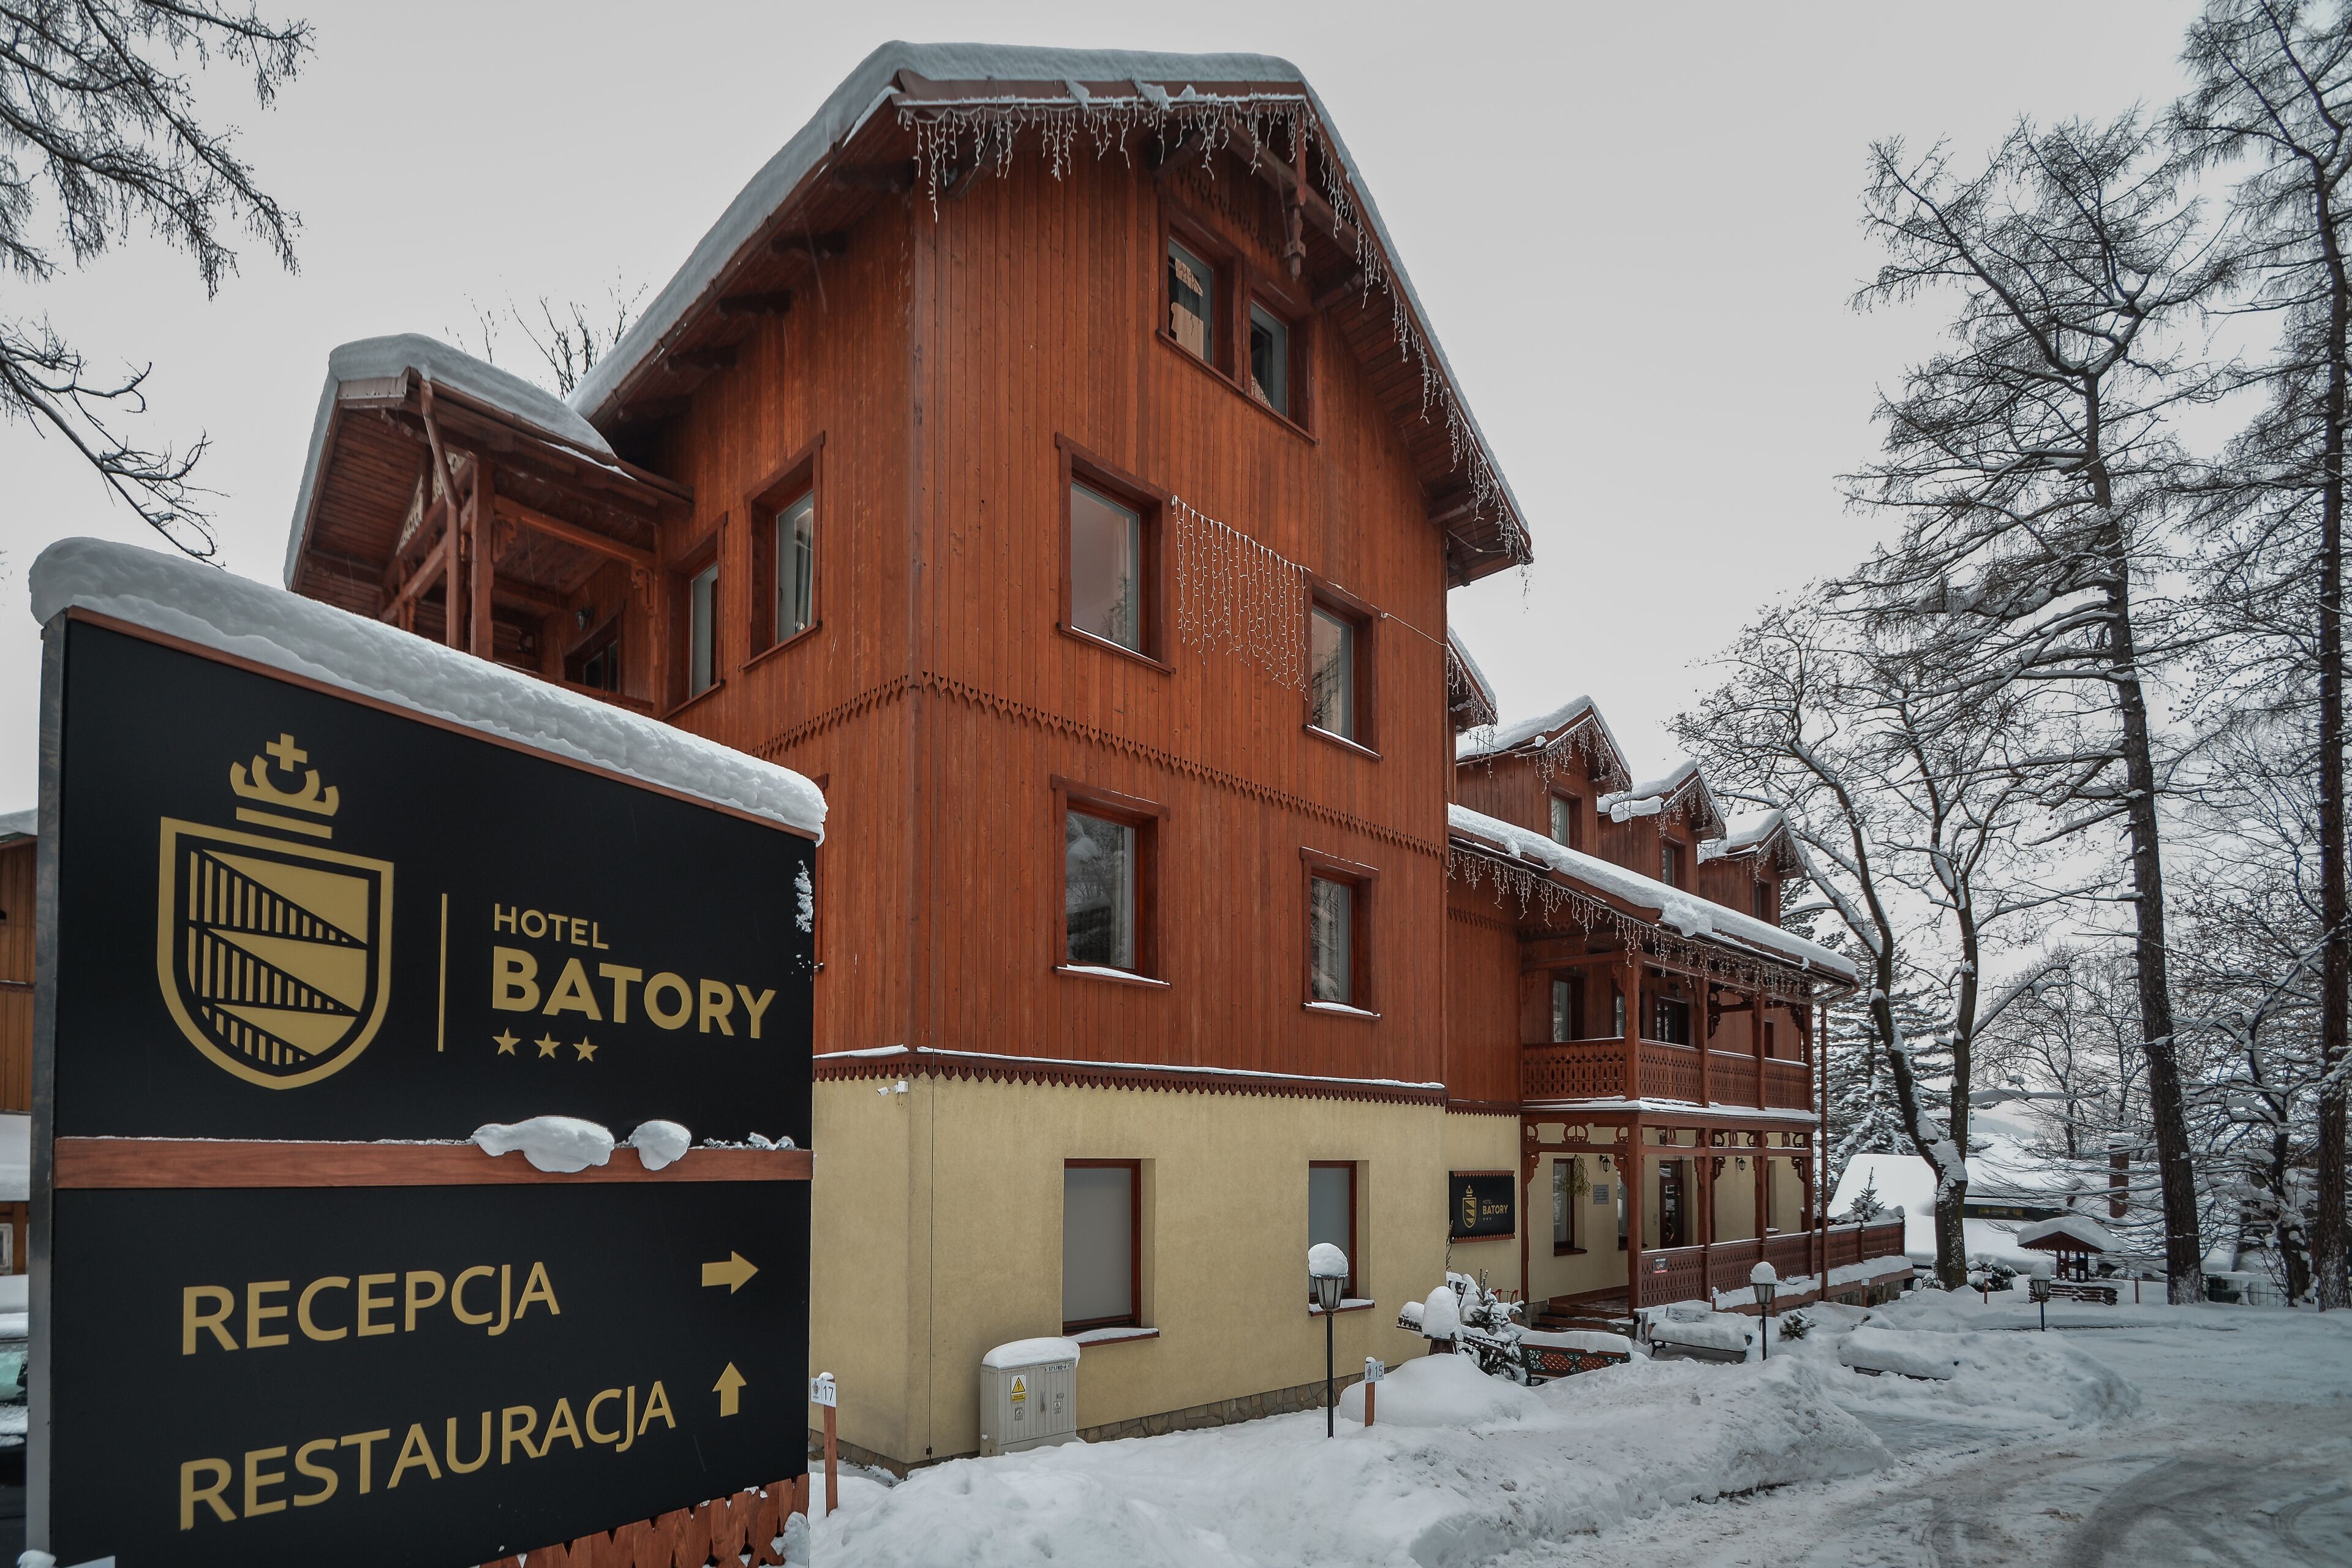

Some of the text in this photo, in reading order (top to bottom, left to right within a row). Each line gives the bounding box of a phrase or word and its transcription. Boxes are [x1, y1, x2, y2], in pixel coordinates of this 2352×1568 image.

[494, 903, 609, 950] HOTEL
[492, 946, 777, 1039] BATORY
[1483, 1204, 1509, 1215] BATORY
[182, 1261, 561, 1355] RECEPCJA
[823, 1385, 834, 1401] 17
[1375, 1365, 1383, 1378] 15
[180, 1380, 676, 1530] RESTAURACJA
